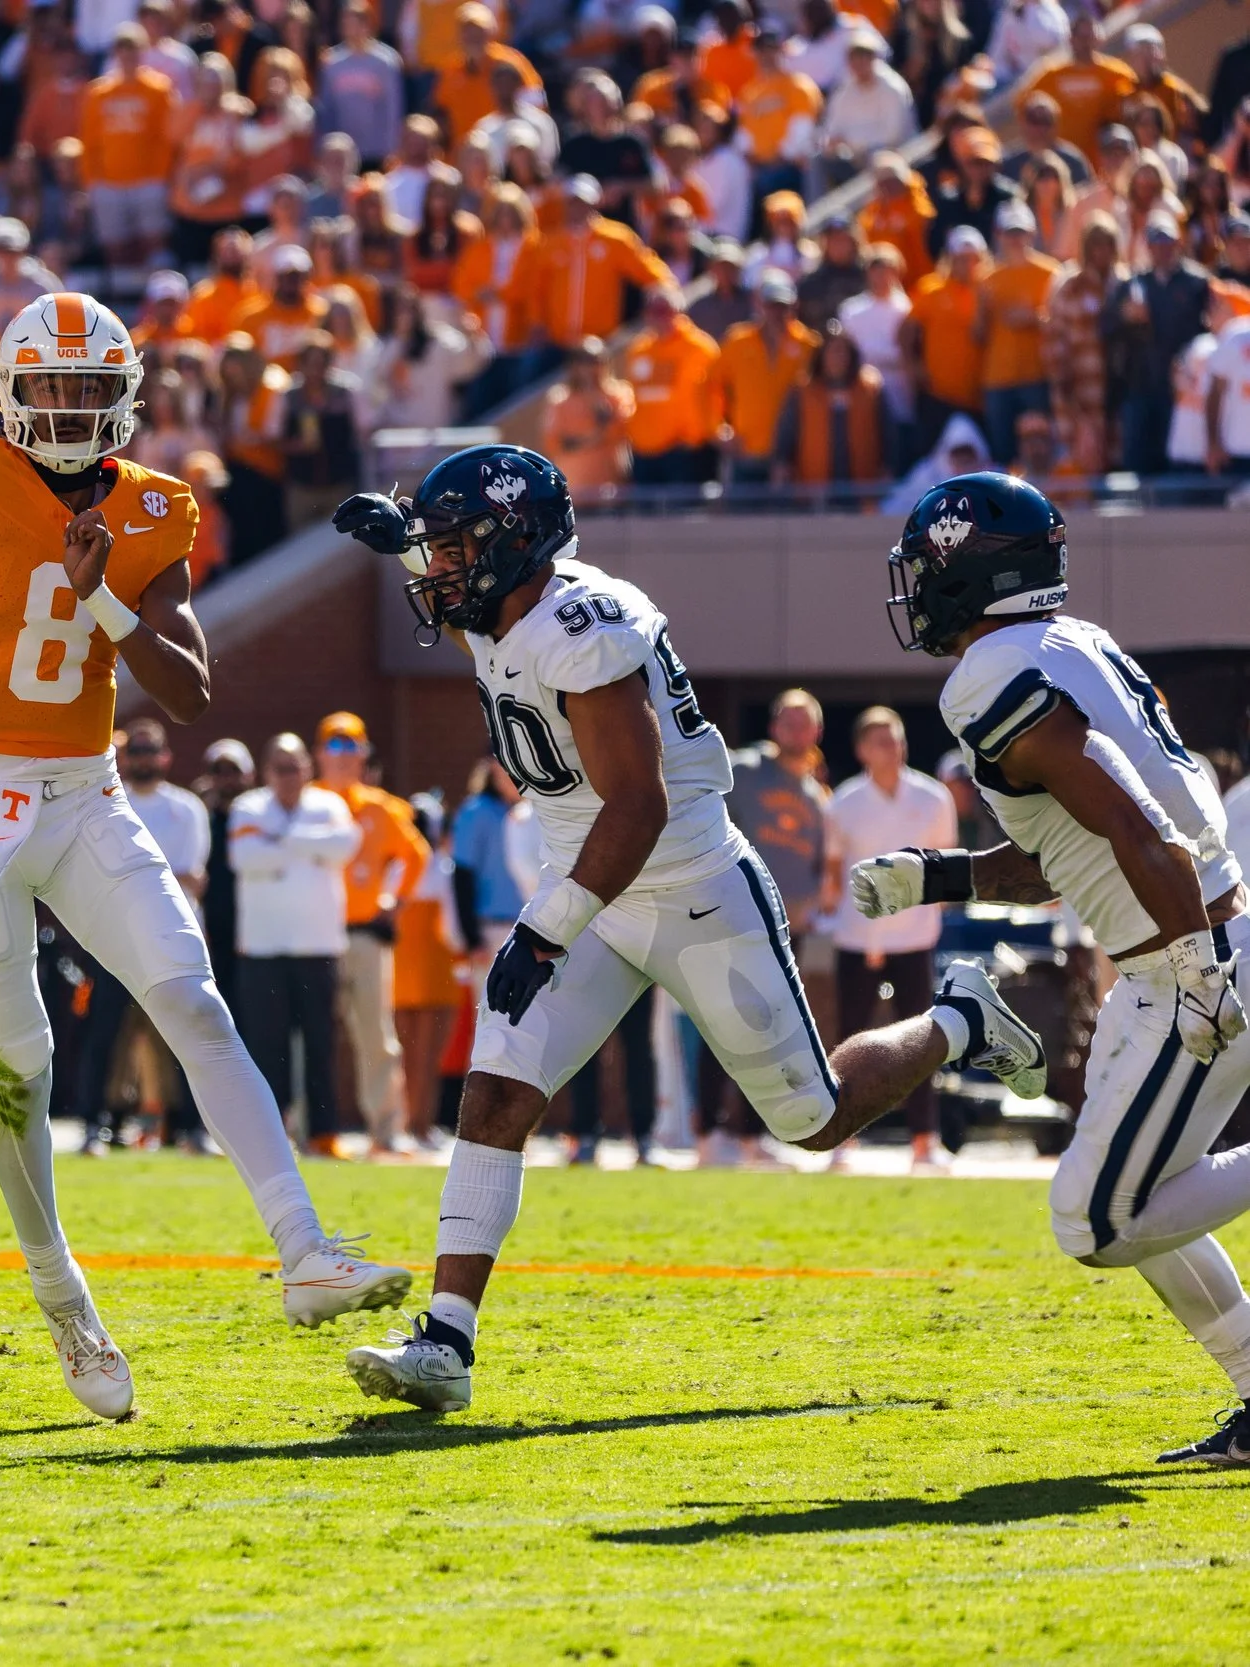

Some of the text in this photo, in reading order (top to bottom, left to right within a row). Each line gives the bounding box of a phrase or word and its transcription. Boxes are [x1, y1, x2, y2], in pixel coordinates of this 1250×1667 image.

[57, 349, 88, 358] VOLS
[142, 491, 169, 517] SEC
[9, 561, 97, 704] 8
[553, 592, 626, 636] 90
[476, 676, 583, 796] 0
[2, 789, 30, 821] T
